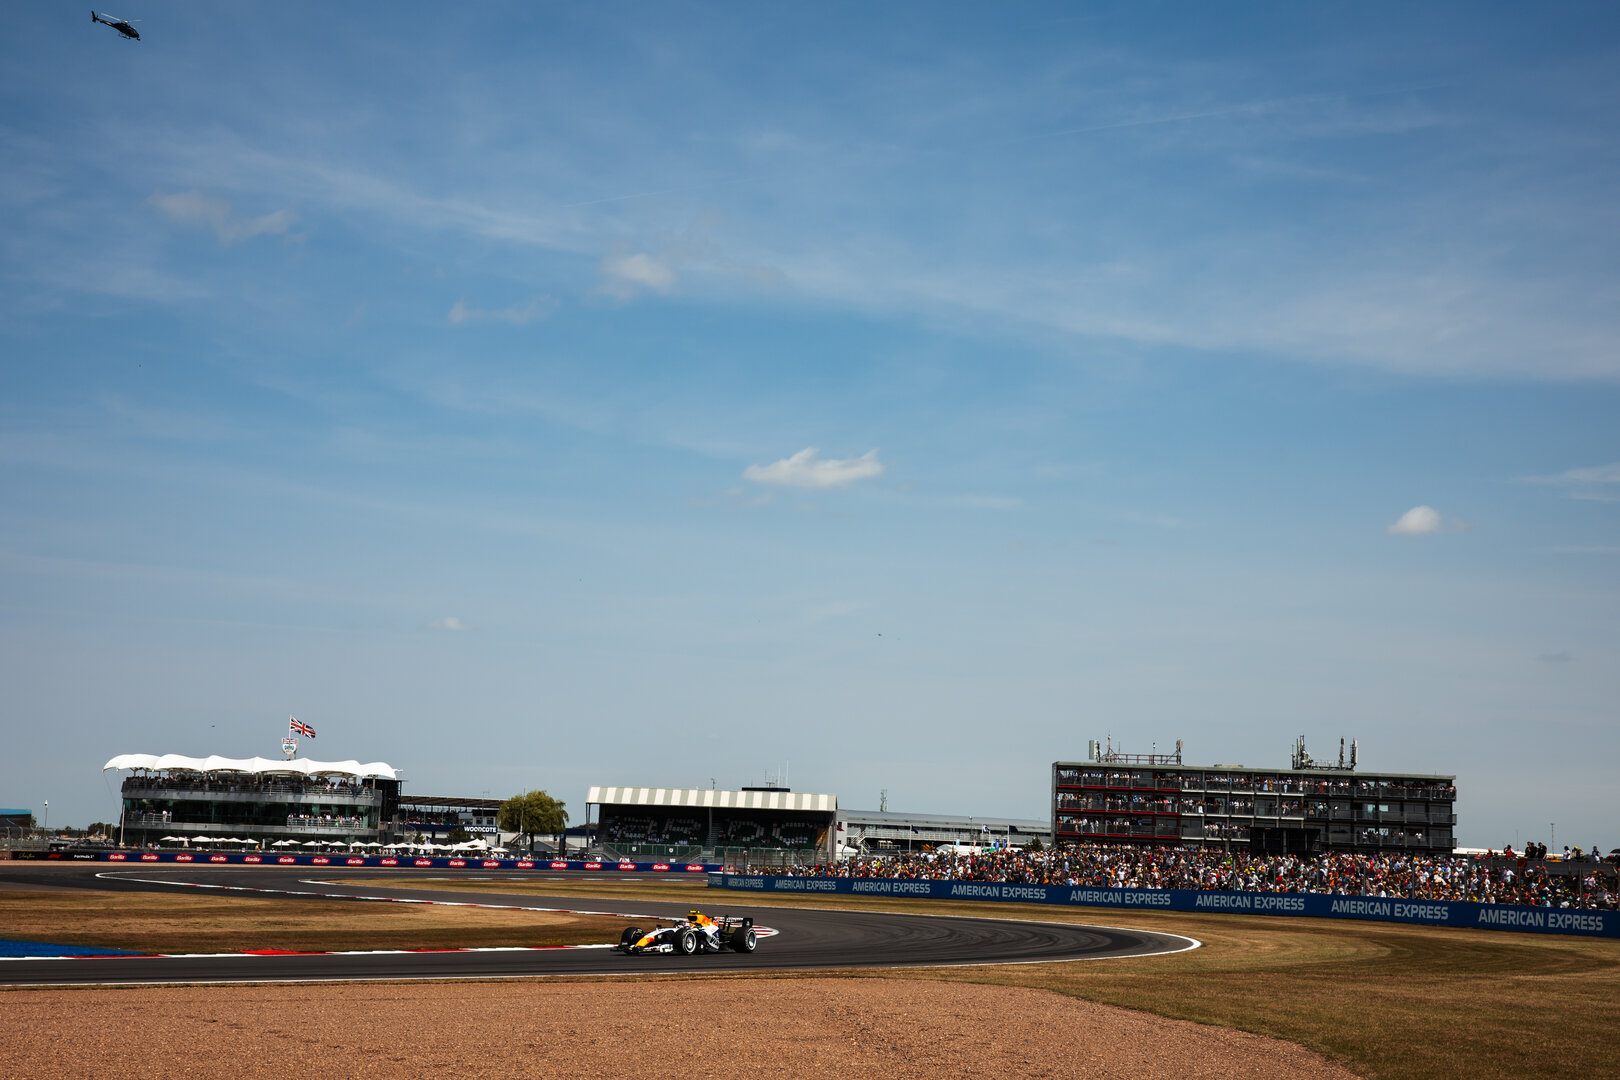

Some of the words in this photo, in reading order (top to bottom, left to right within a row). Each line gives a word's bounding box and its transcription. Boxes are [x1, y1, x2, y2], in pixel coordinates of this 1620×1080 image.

[775, 880, 804, 889] AMERICAN
[806, 881, 836, 890] EXPRESS
[852, 882, 891, 892] AMERICAN
[893, 883, 931, 893] EXPRESS
[952, 885, 1000, 896] AMERICAN
[1002, 887, 1046, 899] EXPRESS
[1070, 890, 1121, 903] AMERICAN
[1124, 892, 1171, 905] EXPRESS
[1195, 895, 1250, 908] AMERICAN
[1254, 897, 1305, 910] EXPRESS
[1331, 900, 1390, 916] AMERICAN
[1394, 904, 1449, 920] EXPRESS
[1478, 909, 1544, 926] AMERICAN
[1548, 914, 1604, 931] EXPRESS
